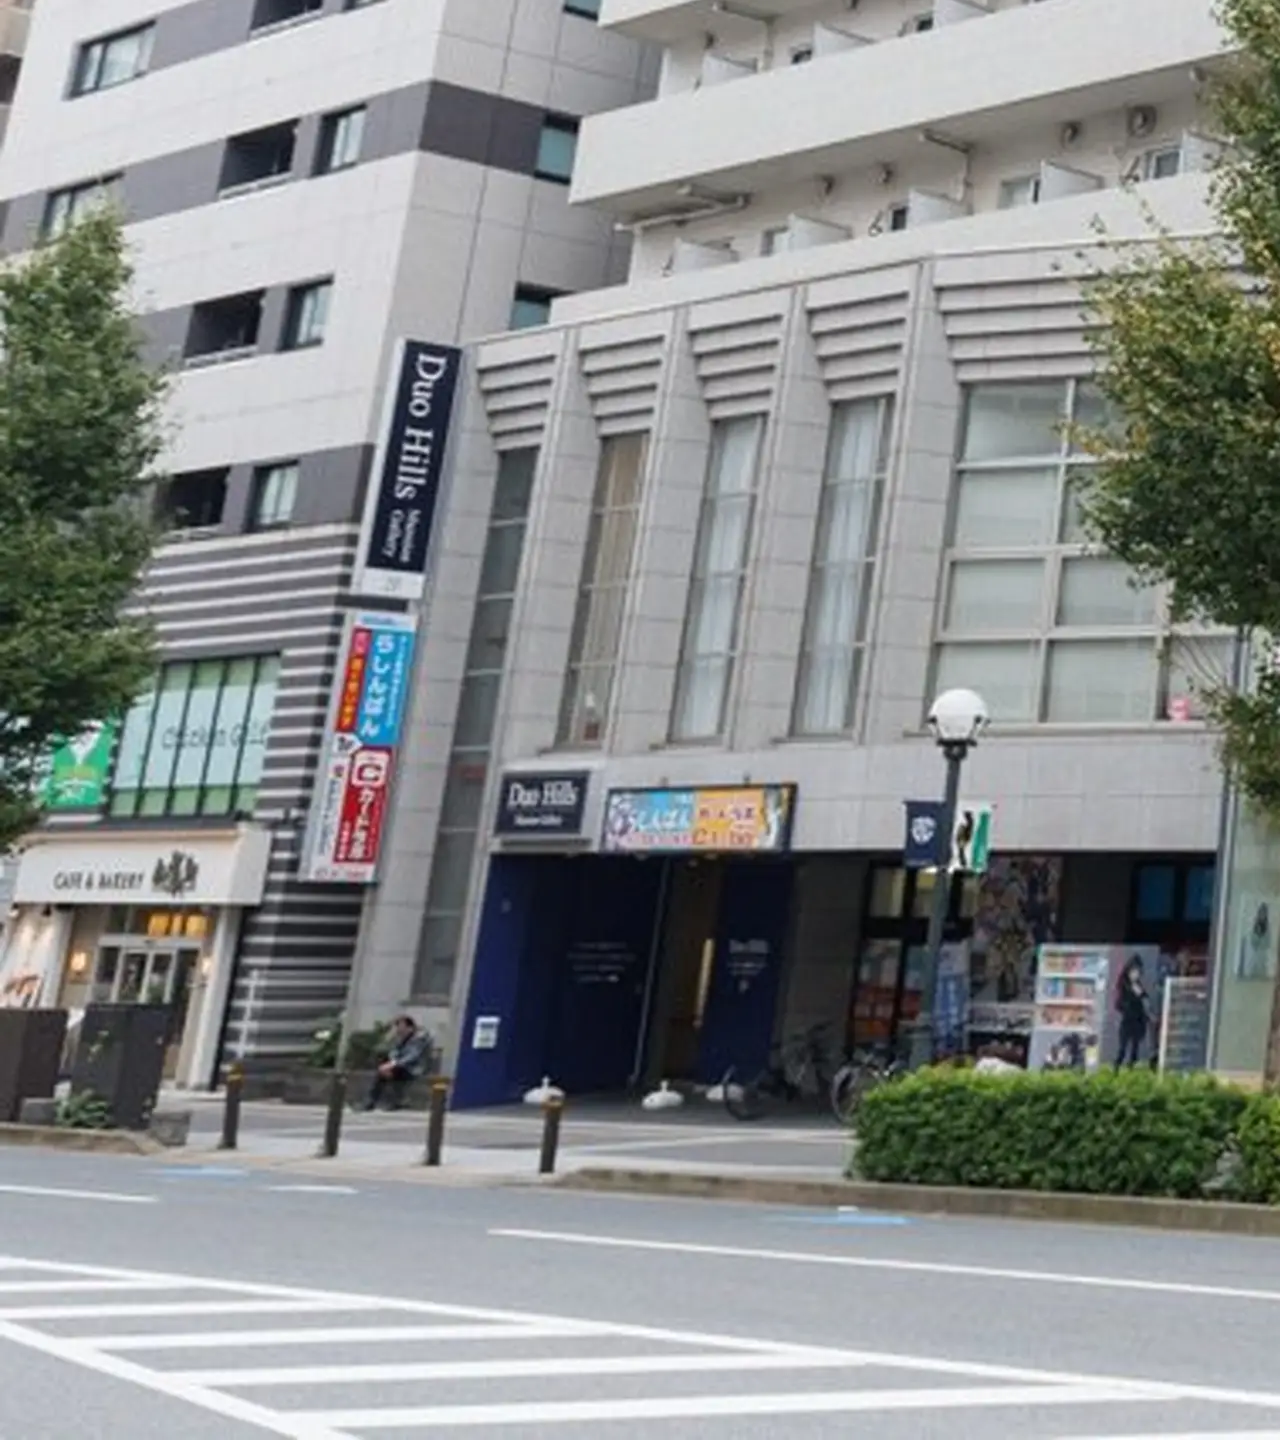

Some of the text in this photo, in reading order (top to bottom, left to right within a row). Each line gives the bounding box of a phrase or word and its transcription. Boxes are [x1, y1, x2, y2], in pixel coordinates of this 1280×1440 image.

[394, 350, 447, 501] Duo Hills
[53, 871, 82, 891] CAFE
[98, 870, 145, 891] BAKERY
